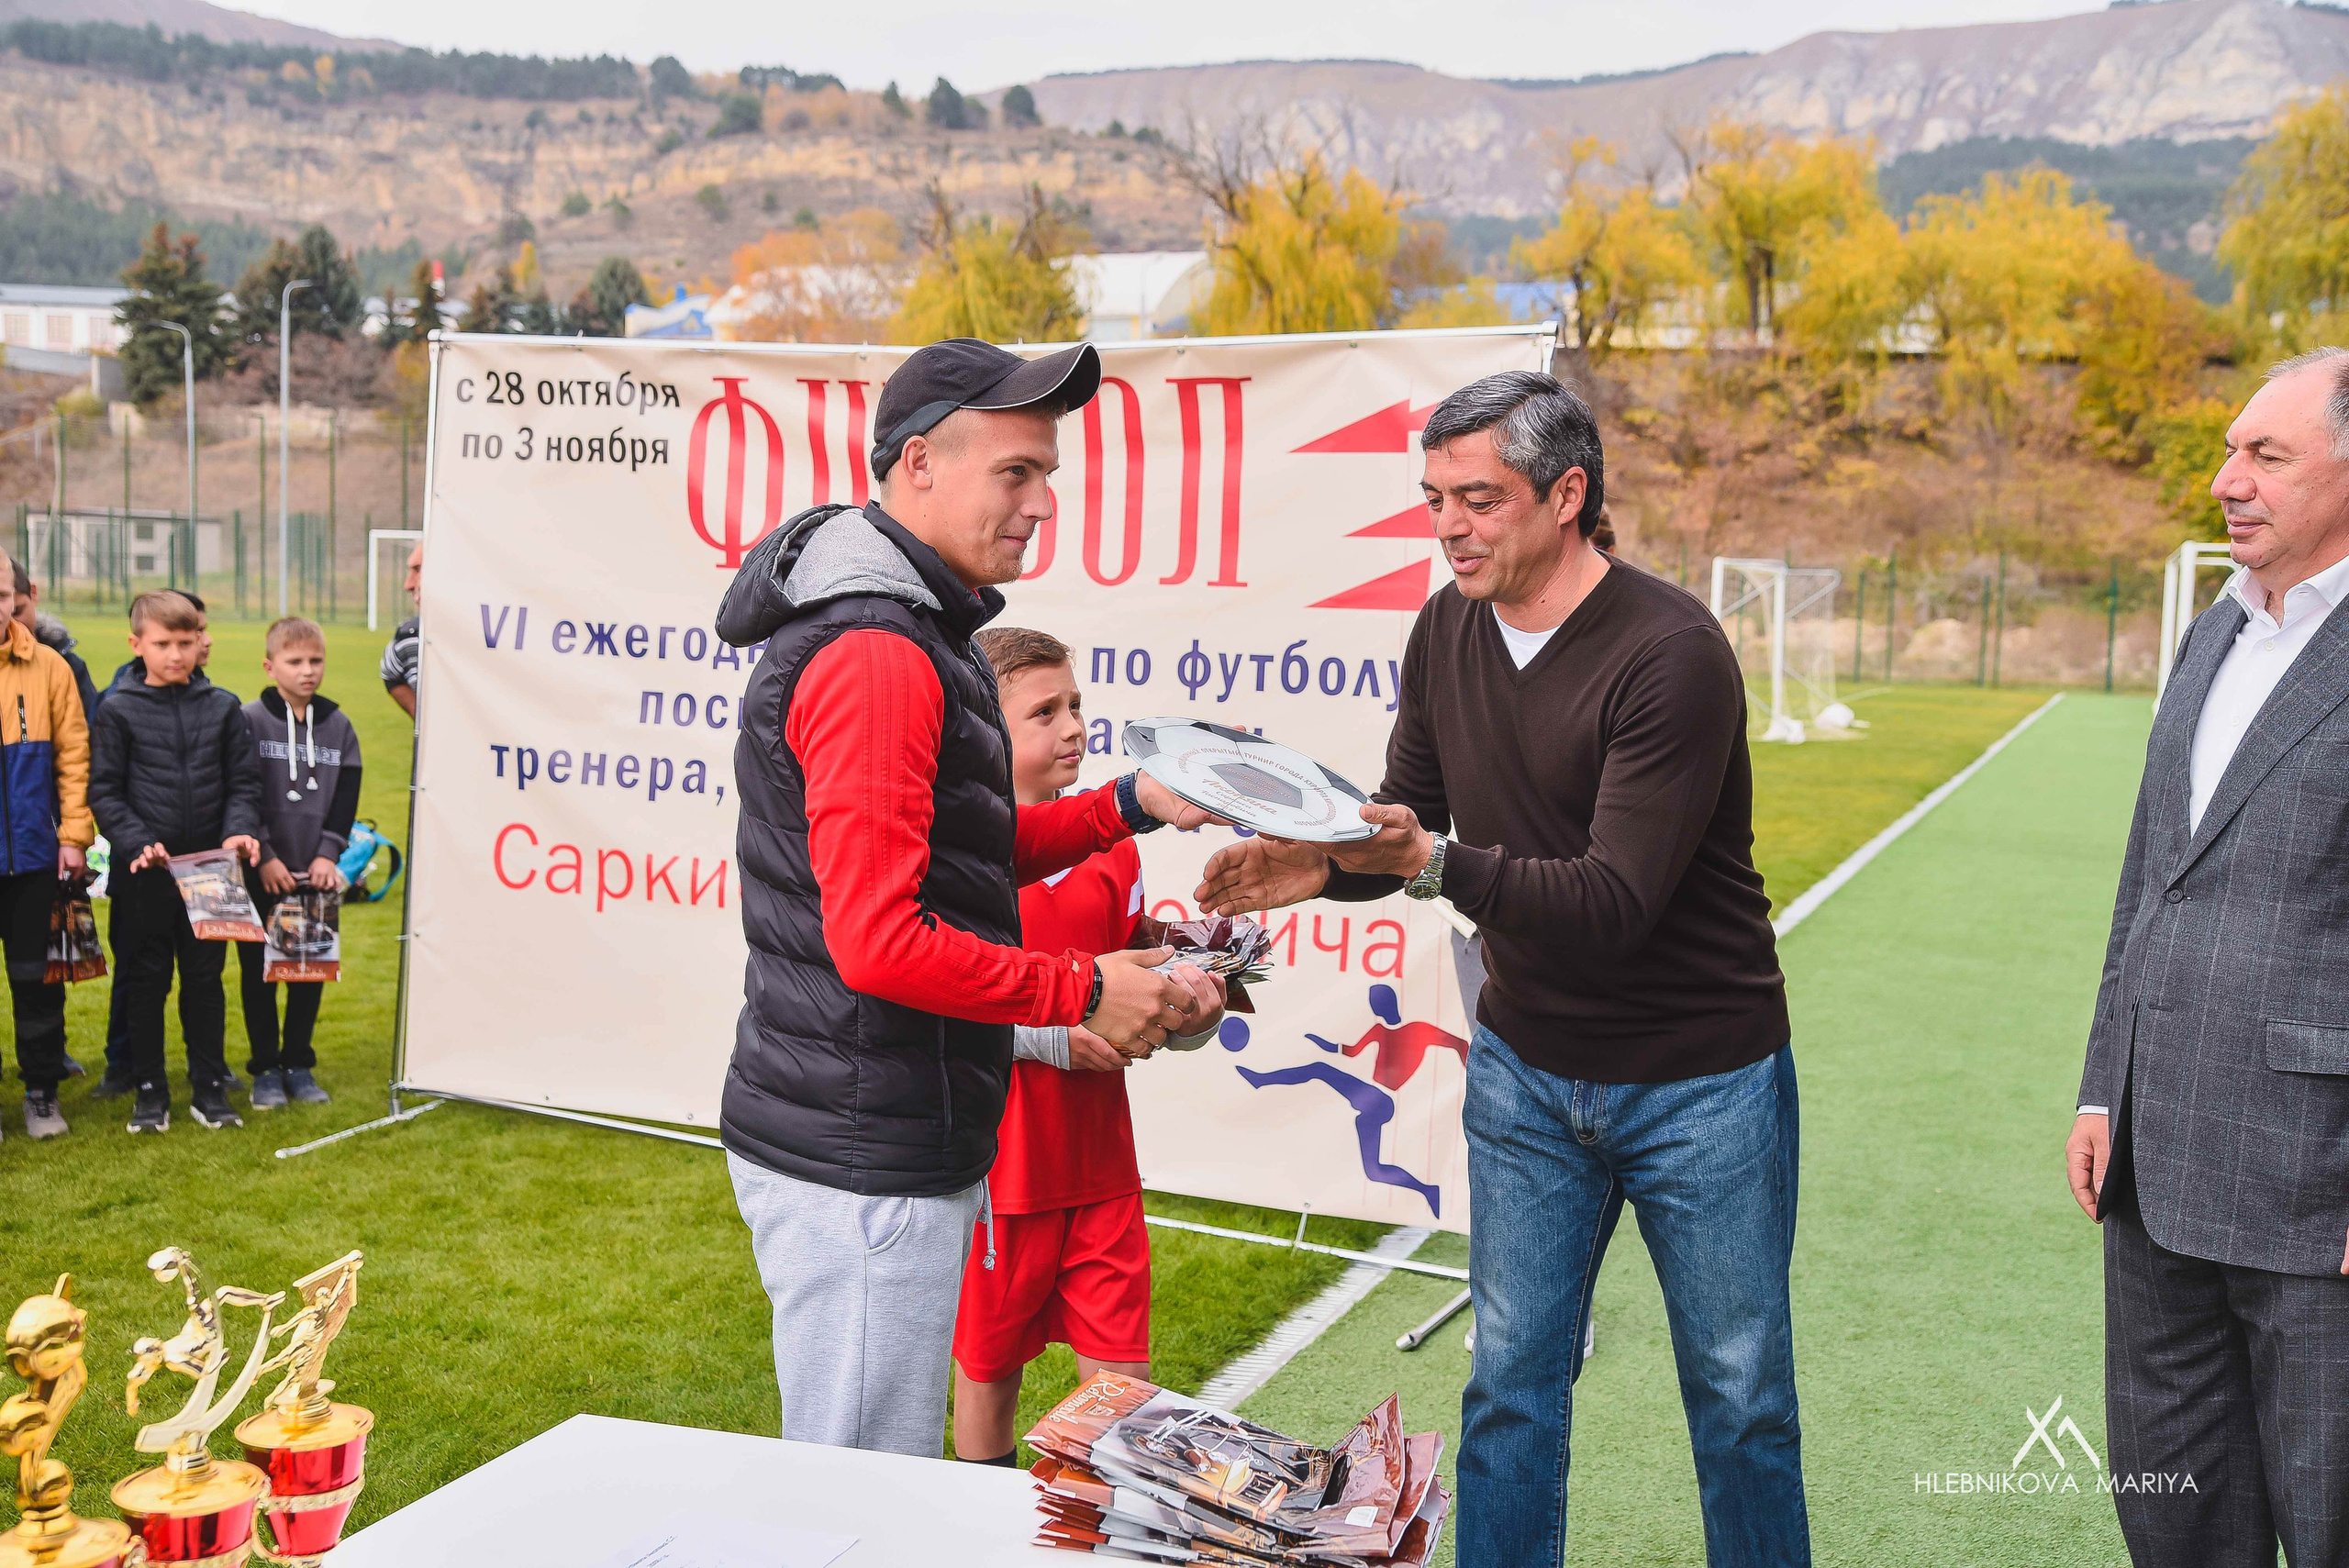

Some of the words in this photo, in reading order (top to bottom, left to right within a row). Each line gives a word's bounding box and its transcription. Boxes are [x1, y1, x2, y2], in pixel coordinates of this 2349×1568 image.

[456, 378, 474, 403] с
[486, 371, 525, 406] 28
[537, 371, 680, 415] октября
[462, 434, 503, 460] по
[515, 427, 534, 461] 3
[546, 427, 668, 472] ноября
[481, 604, 528, 651] VI
[1091, 647, 1152, 686] по
[1178, 639, 1400, 712] футболу
[490, 744, 725, 806] тренера,
[493, 822, 742, 913] Сарки
